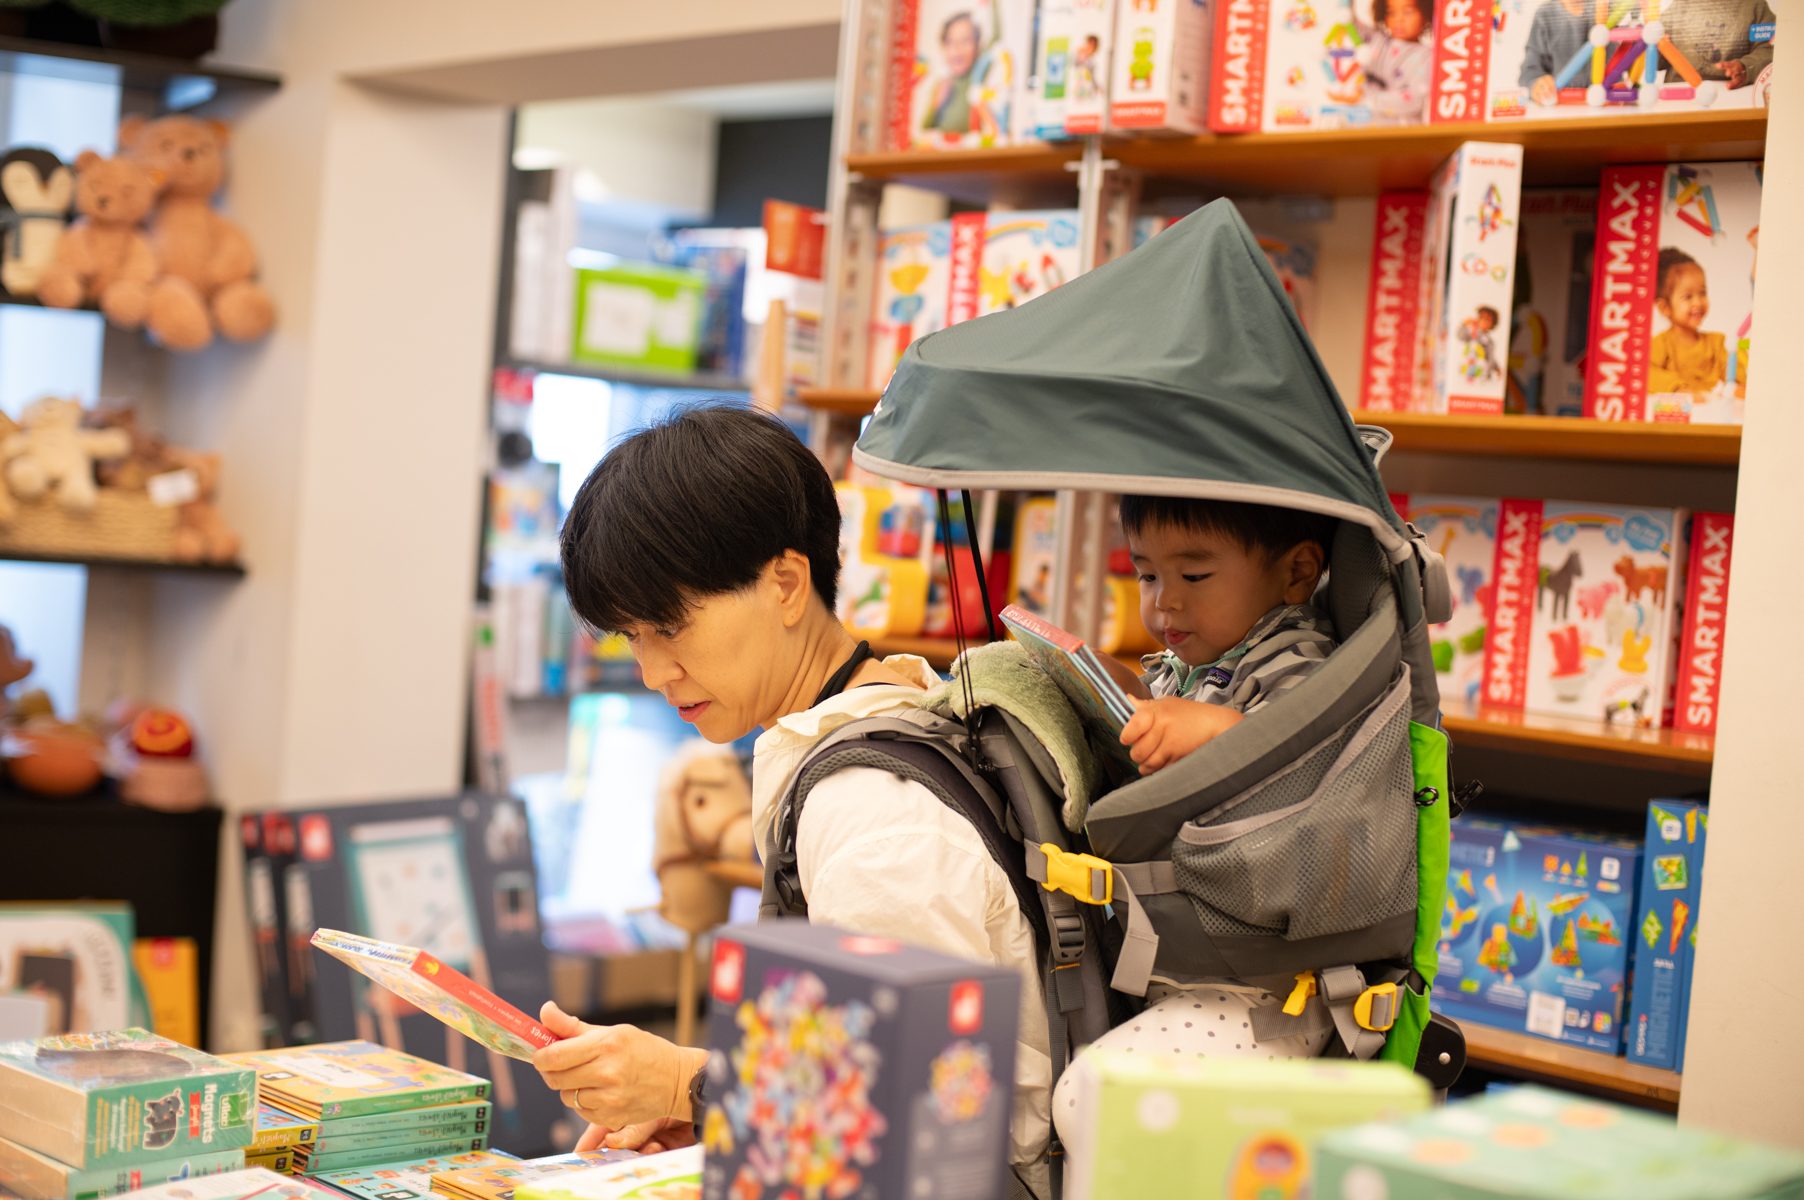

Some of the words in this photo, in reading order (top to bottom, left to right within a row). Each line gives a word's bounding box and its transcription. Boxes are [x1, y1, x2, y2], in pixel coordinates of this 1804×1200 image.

[1595, 180, 1641, 422] SMARTMAX
[1489, 510, 1529, 702] SMARTMAX
[1687, 526, 1729, 727] SMARTMAX
[202, 1083, 217, 1144] Magnets
